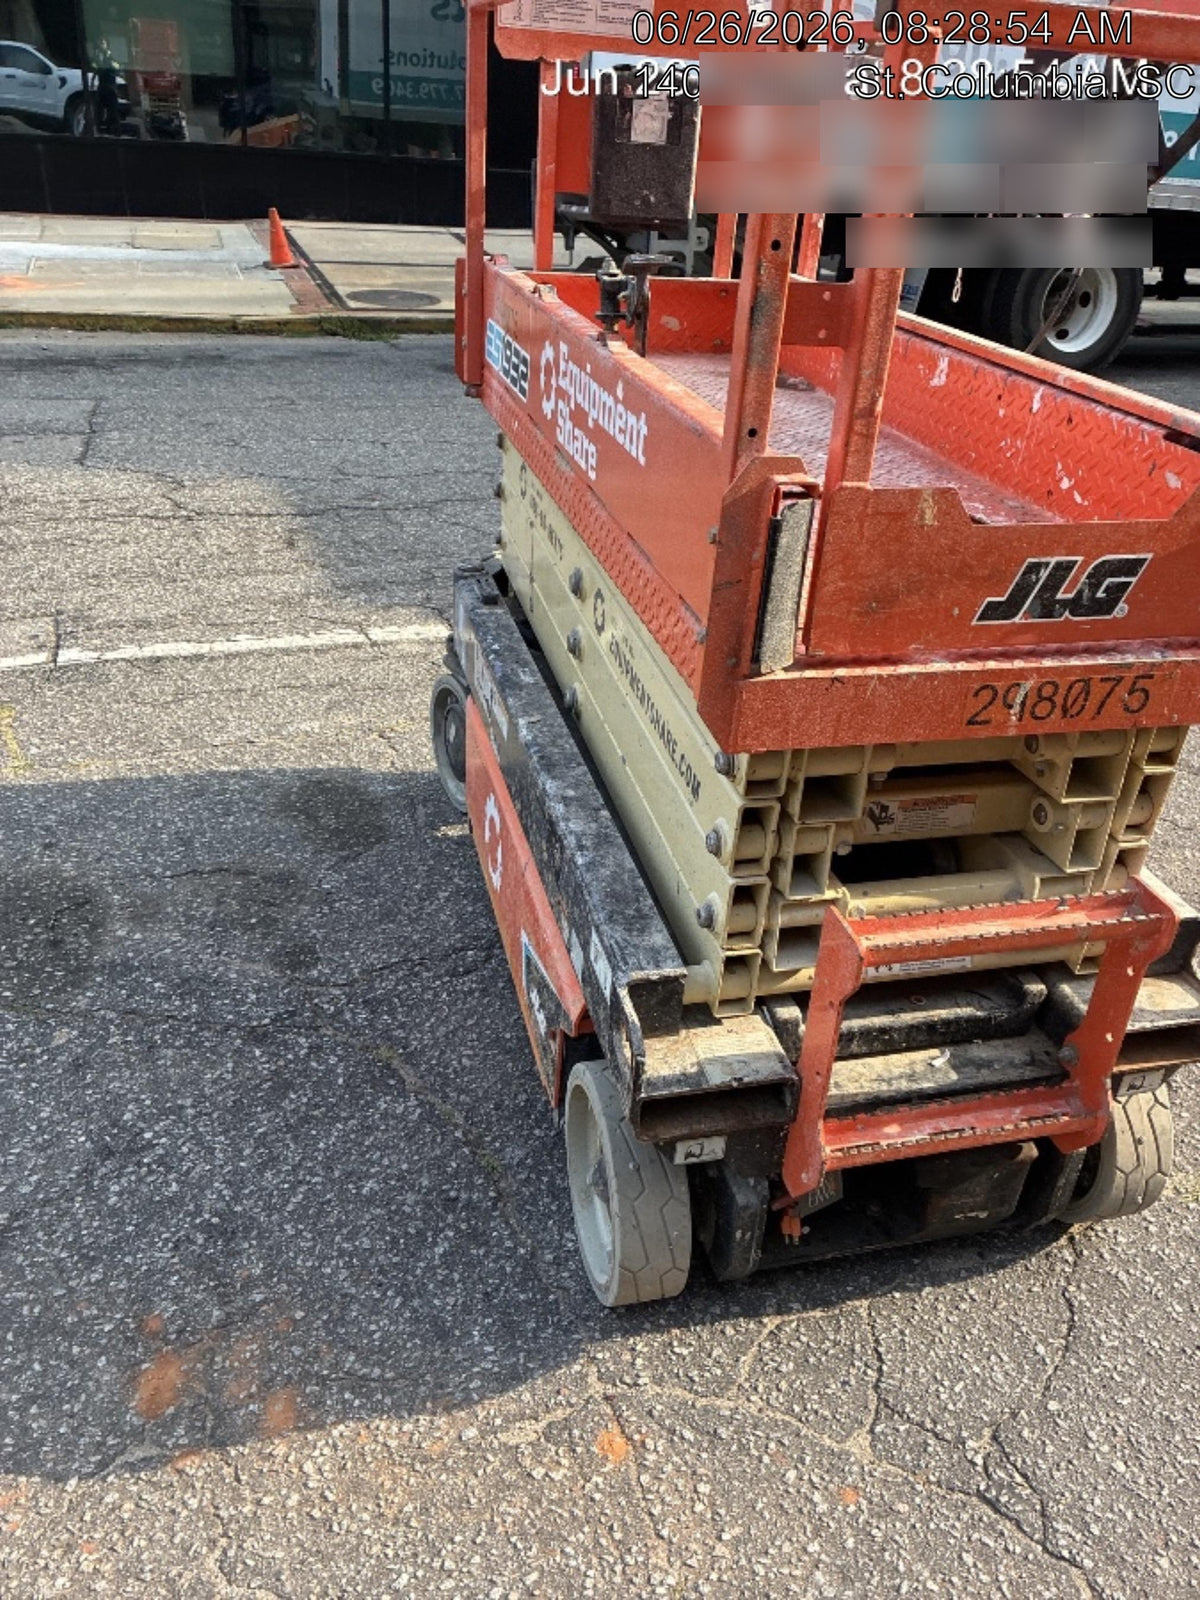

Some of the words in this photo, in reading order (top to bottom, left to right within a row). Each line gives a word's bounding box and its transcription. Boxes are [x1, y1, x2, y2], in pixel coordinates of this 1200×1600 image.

[556, 400, 597, 481] Share
[557, 341, 648, 467] Equipment
[971, 553, 1154, 625] JLG
[965, 673, 1155, 726] 298075
